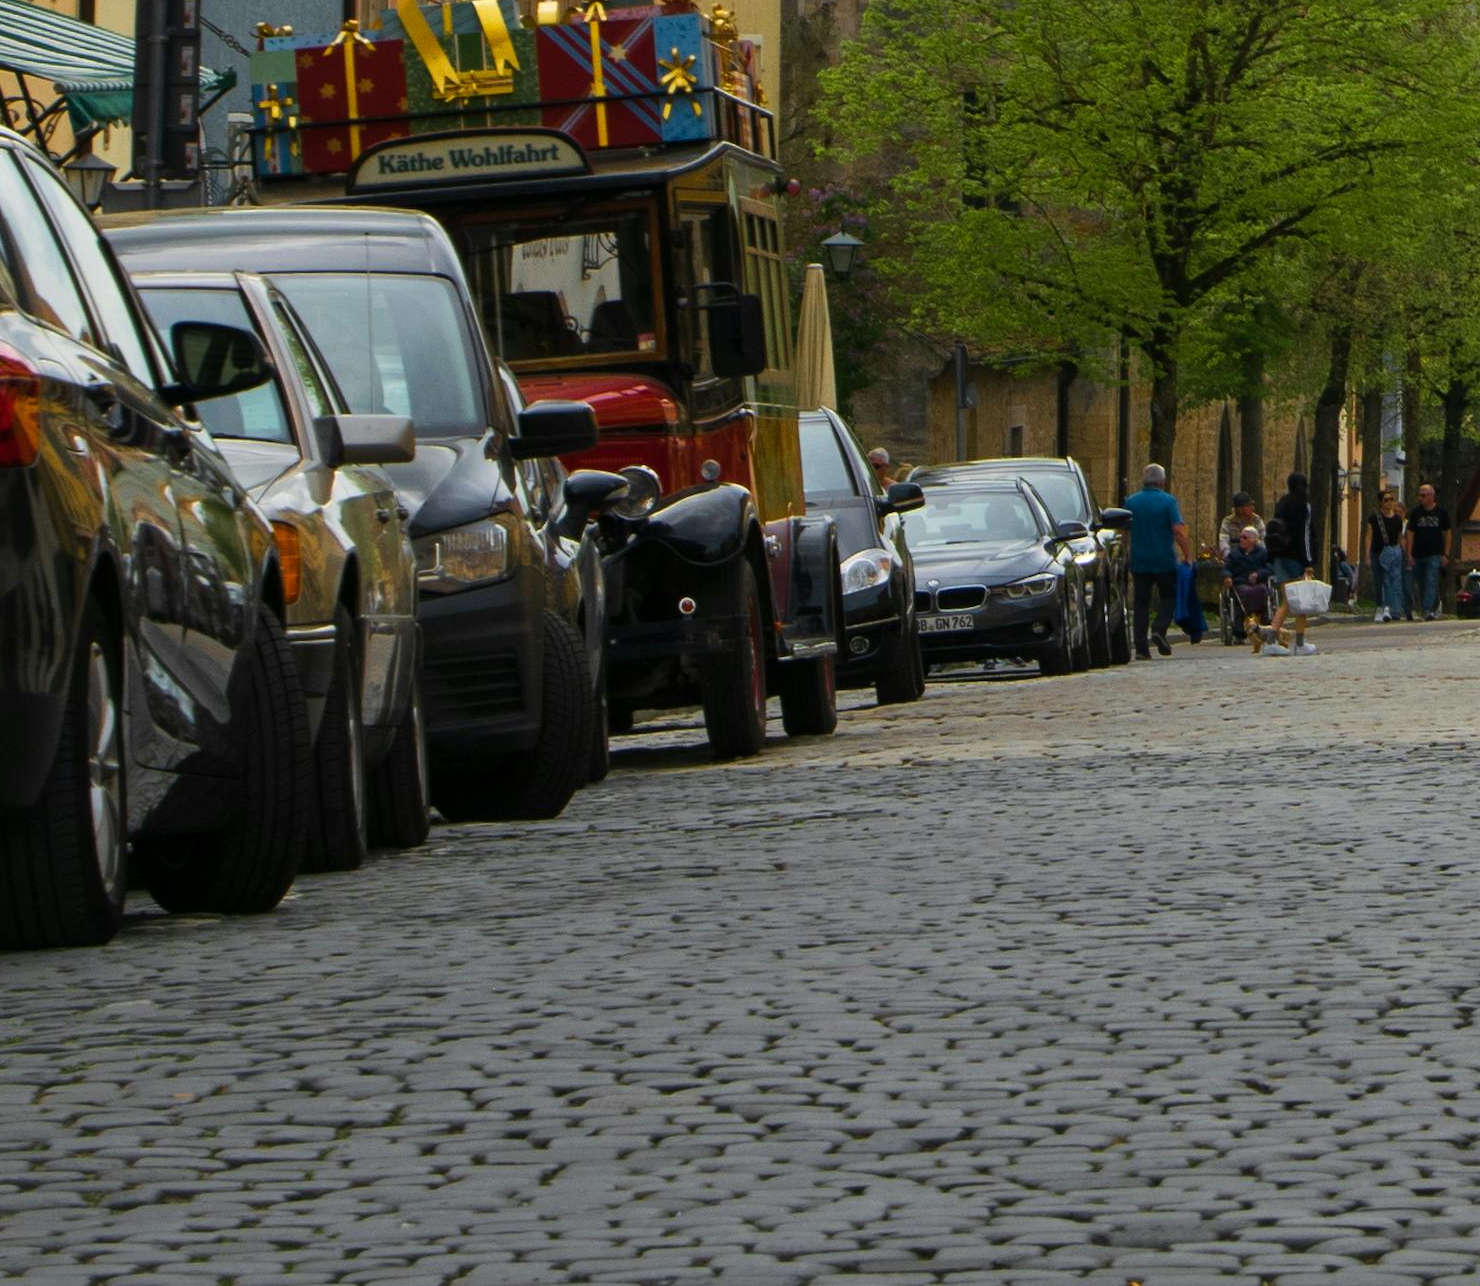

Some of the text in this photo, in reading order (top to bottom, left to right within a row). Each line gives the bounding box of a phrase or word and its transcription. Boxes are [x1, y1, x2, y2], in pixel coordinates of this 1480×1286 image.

[377, 143, 560, 175] Käthe Wohlfahrt
[952, 616, 973, 629] 762
